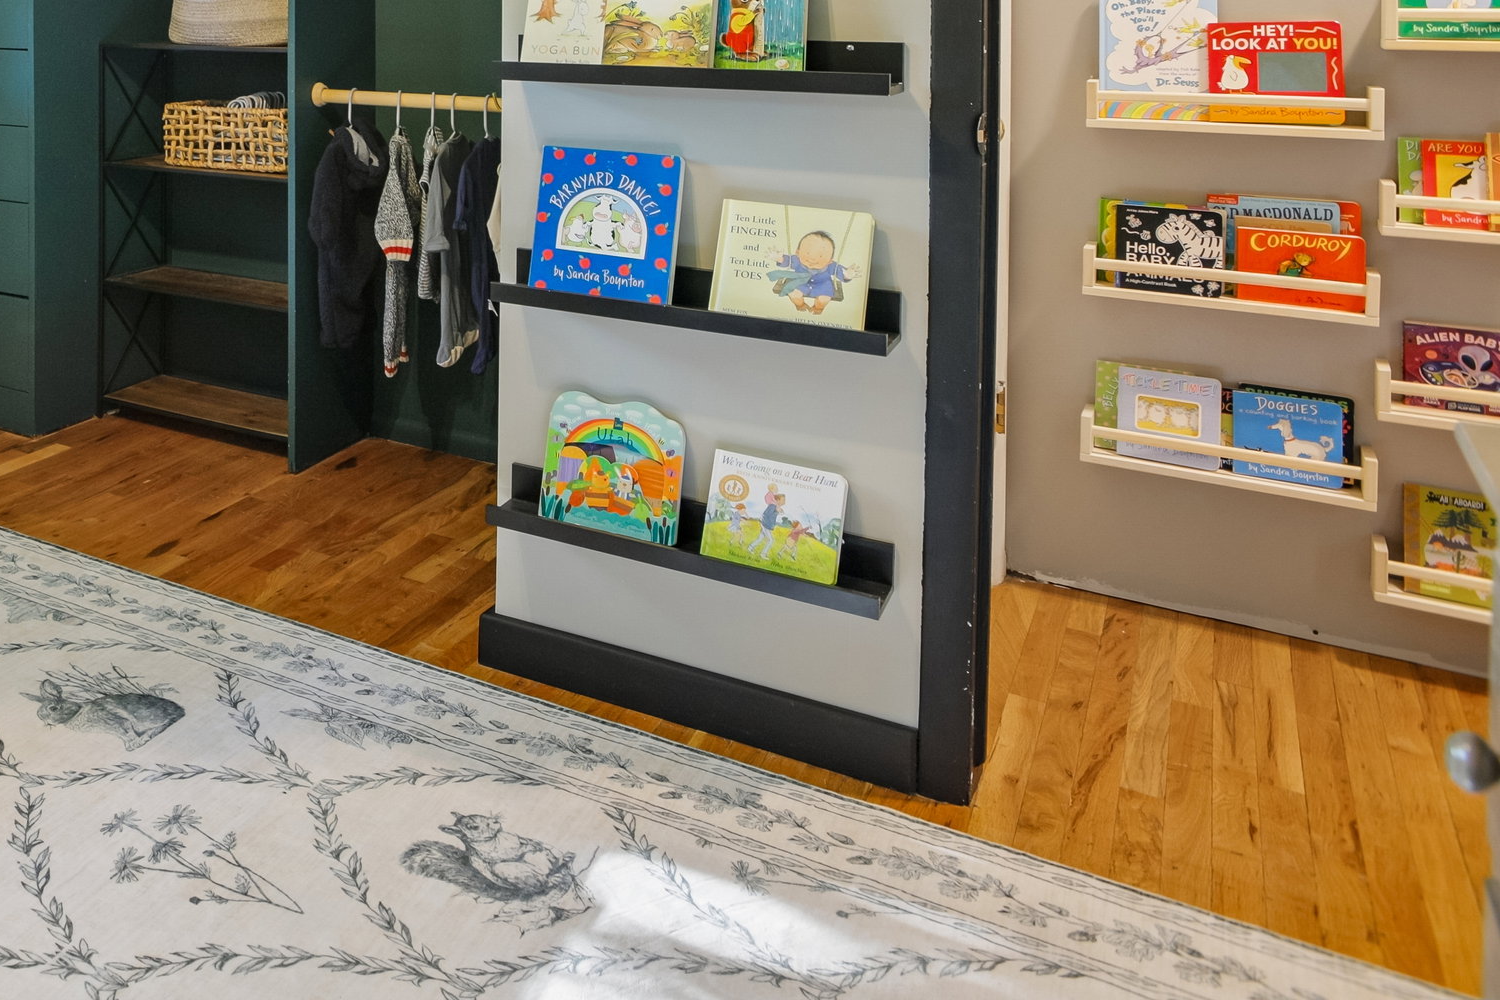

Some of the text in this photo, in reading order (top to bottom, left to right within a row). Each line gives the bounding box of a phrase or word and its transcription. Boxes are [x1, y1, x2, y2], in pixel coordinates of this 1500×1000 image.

[1136, 7, 1166, 15] Places
[1137, 22, 1159, 32] Go!
[1253, 25, 1294, 36] HEY!
[1413, 25, 1424, 33] by
[1426, 24, 1459, 32] Sandra
[532, 44, 568, 55] YOGA
[1212, 38, 1337, 50] LOOK AT YOU!
[1156, 77, 1200, 87] Dr. Seuss
[1280, 108, 1323, 119] Boynton
[1428, 143, 1453, 152] ARE
[1457, 144, 1482, 153] YOU
[550, 172, 660, 216] BARNYARD DANCE!
[735, 214, 776, 225] Ten Little
[1243, 208, 1333, 221] MACDONALD
[1442, 214, 1488, 224] by Sandra
[730, 226, 777, 238] FINGERS
[743, 243, 759, 252] and
[1126, 241, 1171, 256] Hello,
[1250, 232, 1352, 264] CORDUROY
[730, 256, 770, 268] Ten Little
[553, 265, 645, 290] by Sandra Boynton
[734, 270, 762, 280] TOES
[1416, 332, 1500, 351] ALIEN BAB
[1123, 373, 1172, 392] TICKLE
[1174, 379, 1218, 398] TIME!
[1254, 396, 1318, 416] DOGGIES
[1245, 409, 1274, 418] counting
[1291, 414, 1318, 424] barking
[597, 427, 633, 446] Utah
[722, 455, 743, 467] We're
[746, 461, 771, 475] Going
[773, 468, 782, 476] on
[792, 470, 813, 482] Bear
[815, 475, 838, 487] Hunt
[1248, 463, 1329, 482] by Sandra Boynton
[796, 483, 821, 492] EDITION
